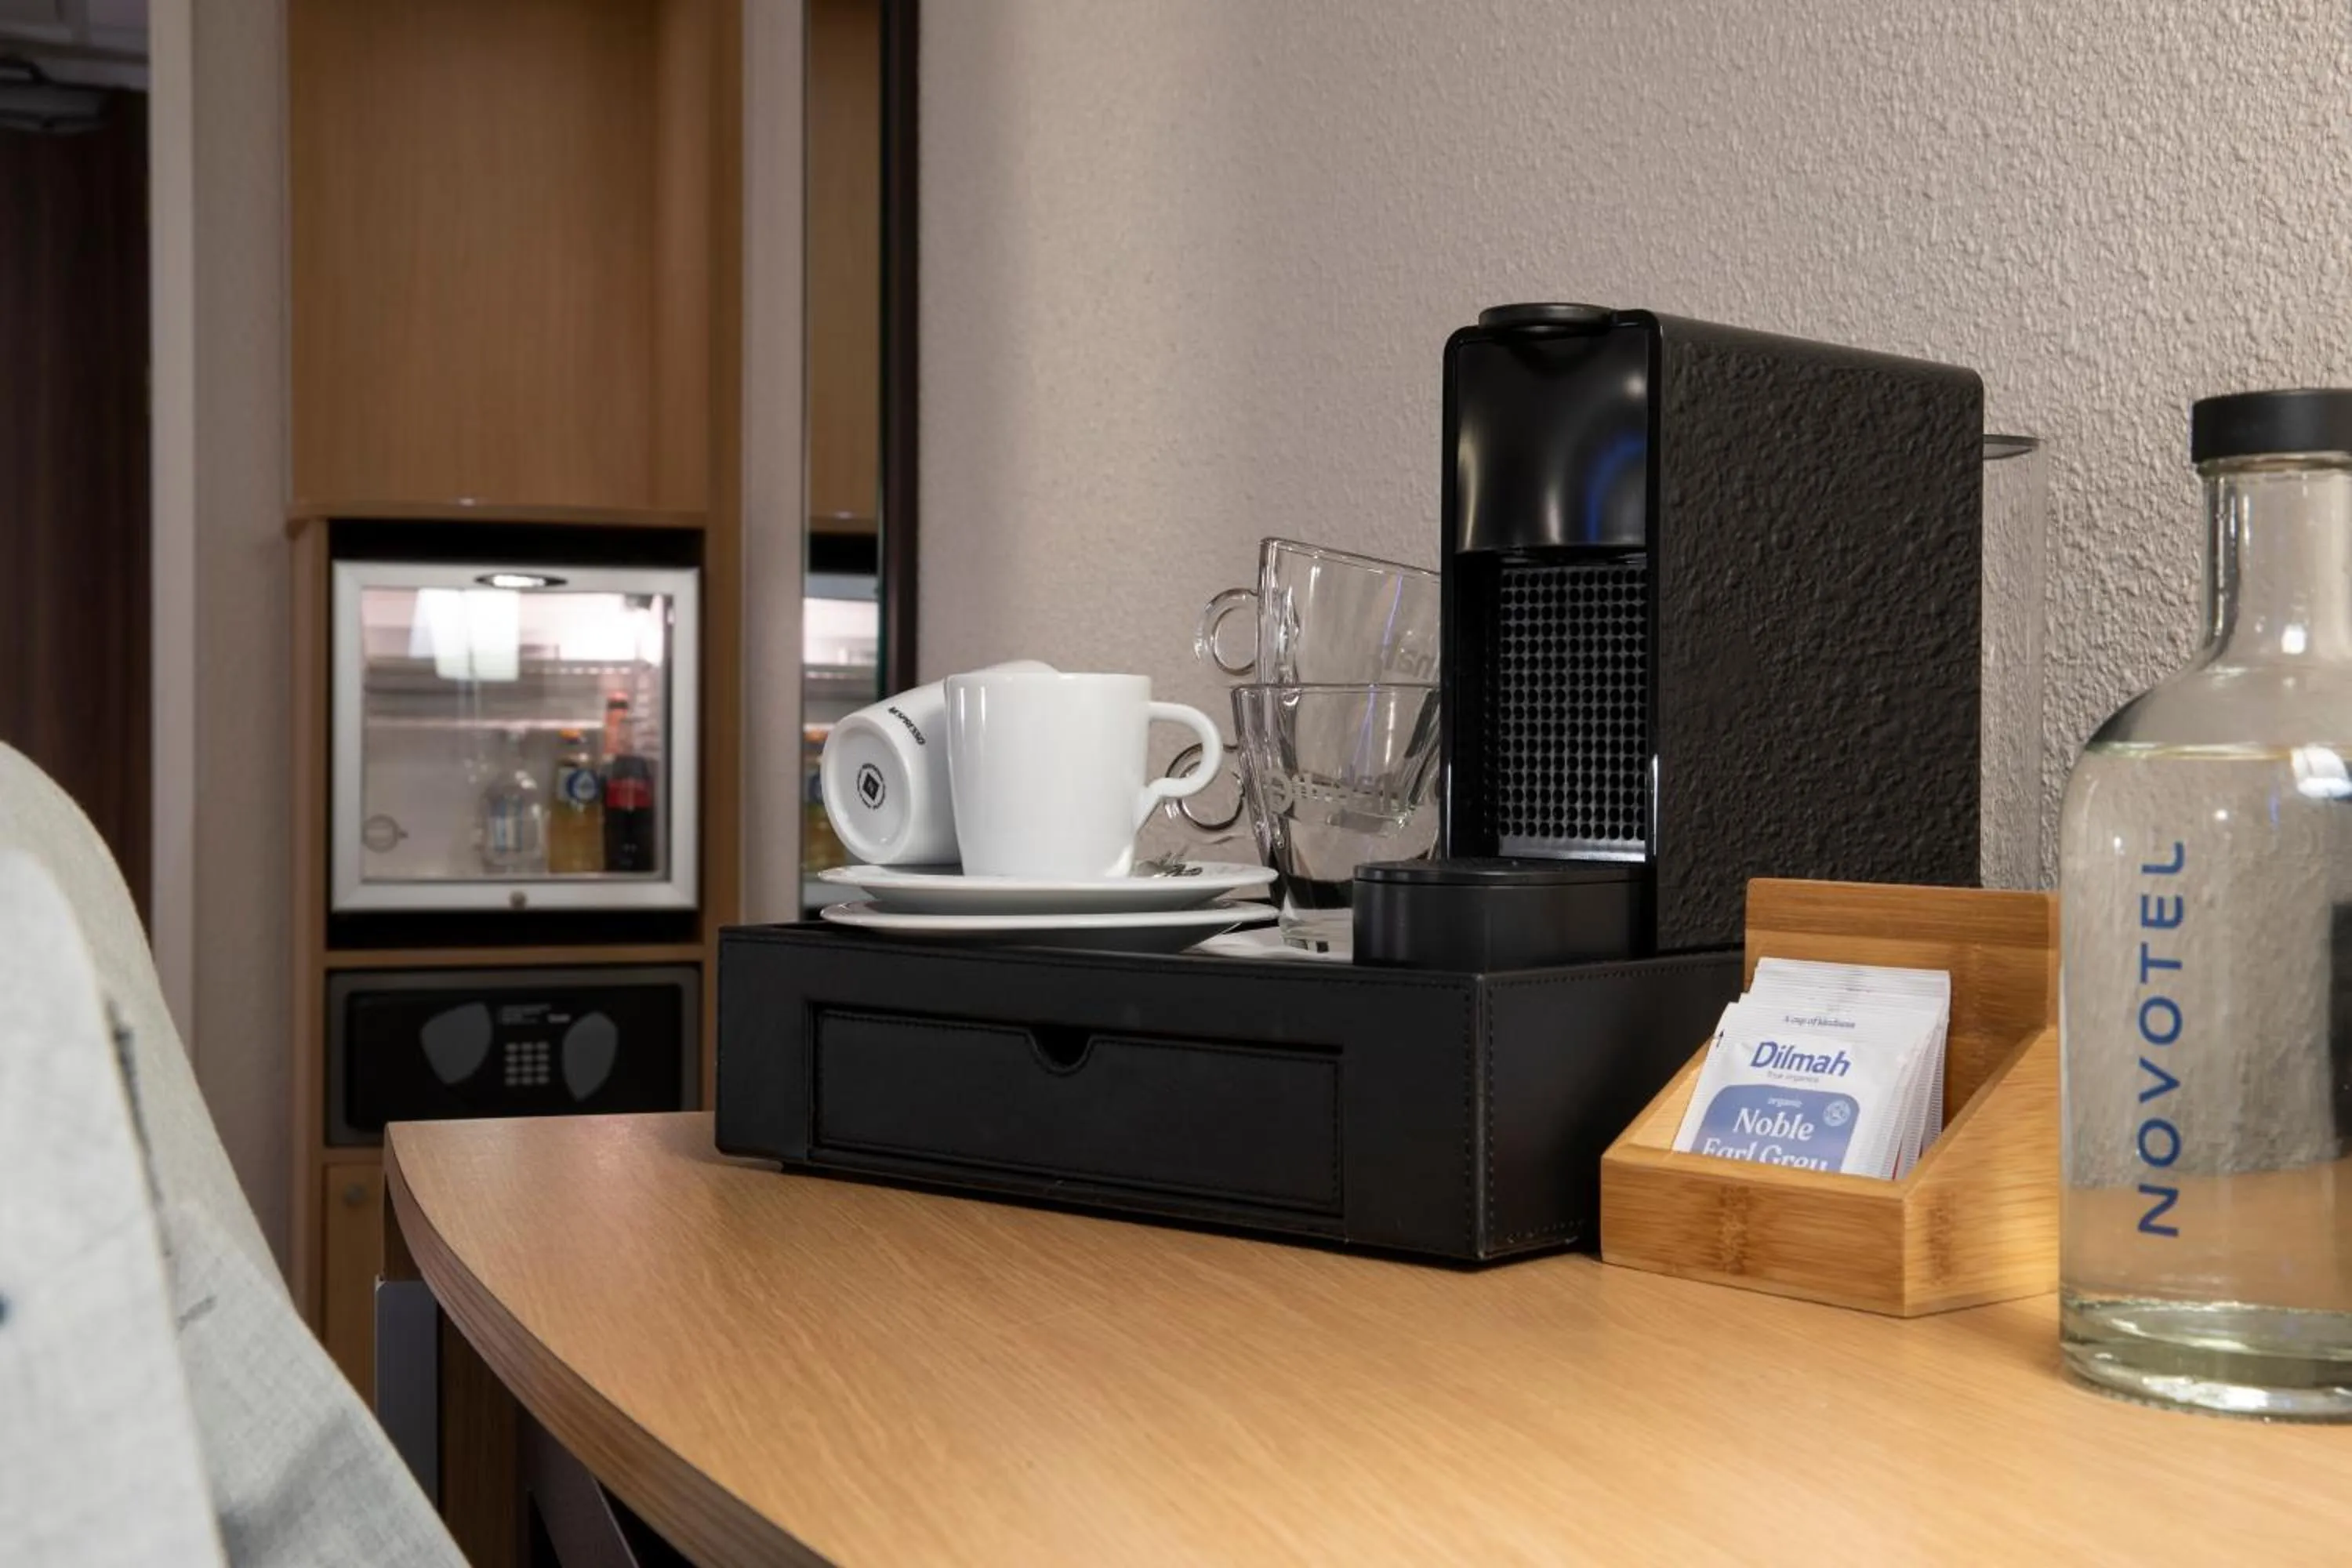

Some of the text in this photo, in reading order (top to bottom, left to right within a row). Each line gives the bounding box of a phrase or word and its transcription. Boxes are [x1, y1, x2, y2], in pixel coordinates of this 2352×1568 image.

[2136, 840, 2185, 1238] NOVOTEL
[1750, 1040, 1852, 1077] Dilmah
[1732, 1106, 1816, 1142] Noble
